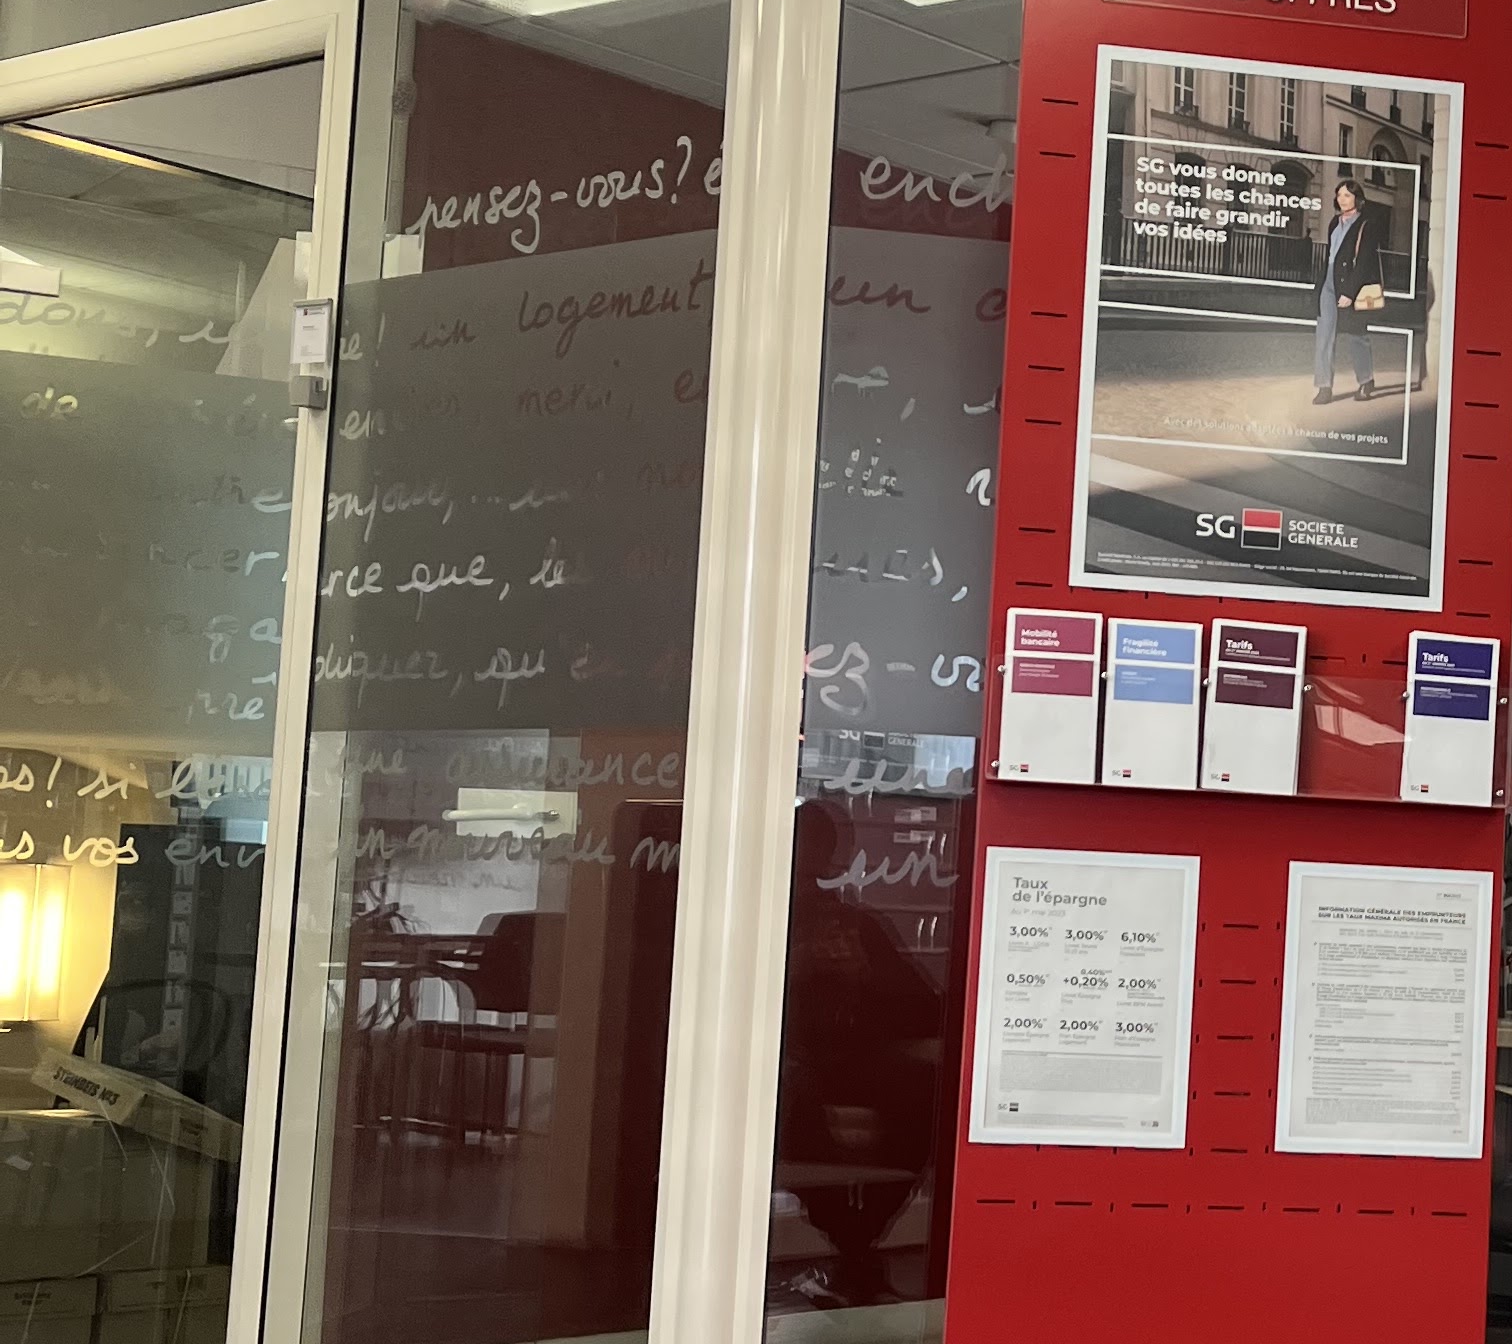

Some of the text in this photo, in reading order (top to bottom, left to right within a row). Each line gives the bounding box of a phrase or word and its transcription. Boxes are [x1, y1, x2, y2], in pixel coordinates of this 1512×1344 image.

[1136, 156, 1287, 186] SG vous donne
[1136, 177, 1322, 211] toutes les chances
[1134, 199, 1290, 229] de faire grandir
[1134, 221, 1227, 243] vos idées
[1295, 427, 1327, 438] chacun
[1328, 429, 1339, 440] de
[1340, 432, 1356, 441] vos
[1357, 432, 1389, 445] projets
[1196, 512, 1345, 539] SG SOCIETE
[1287, 532, 1359, 548] GENERALE
[1020, 628, 1058, 639] Mobilité
[1020, 637, 1060, 648] bancaire
[1122, 637, 1160, 649] Fragilité
[1225, 639, 1253, 650] Tarifs
[1121, 646, 1167, 657] financière
[1422, 652, 1449, 663] Tarifs
[62, 832, 141, 868] vos
[1012, 876, 1049, 890] Taux
[1012, 890, 1108, 908] de l'épargne
